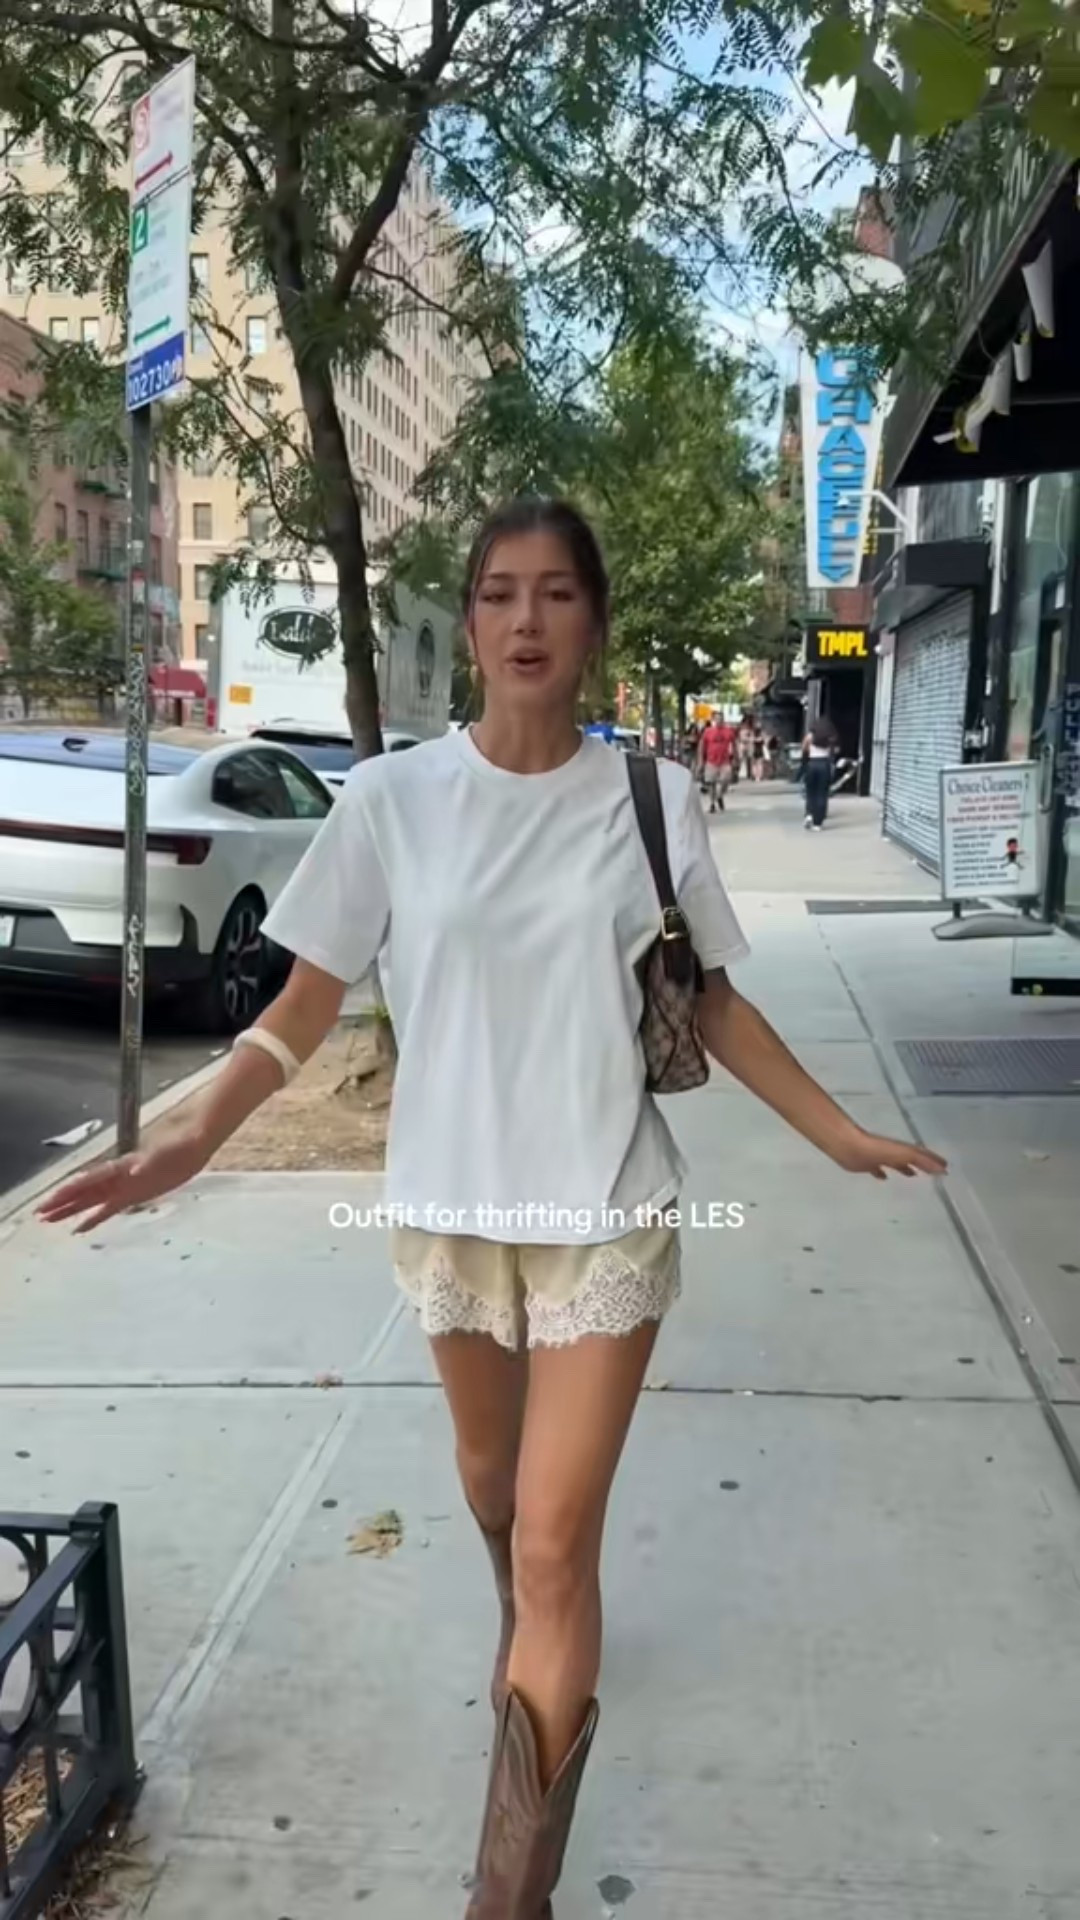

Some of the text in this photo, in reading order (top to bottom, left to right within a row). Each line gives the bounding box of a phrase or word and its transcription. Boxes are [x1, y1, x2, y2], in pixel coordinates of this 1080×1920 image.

[817, 630, 868, 657] TMPL
[948, 775, 1022, 795] Choice Cleaners
